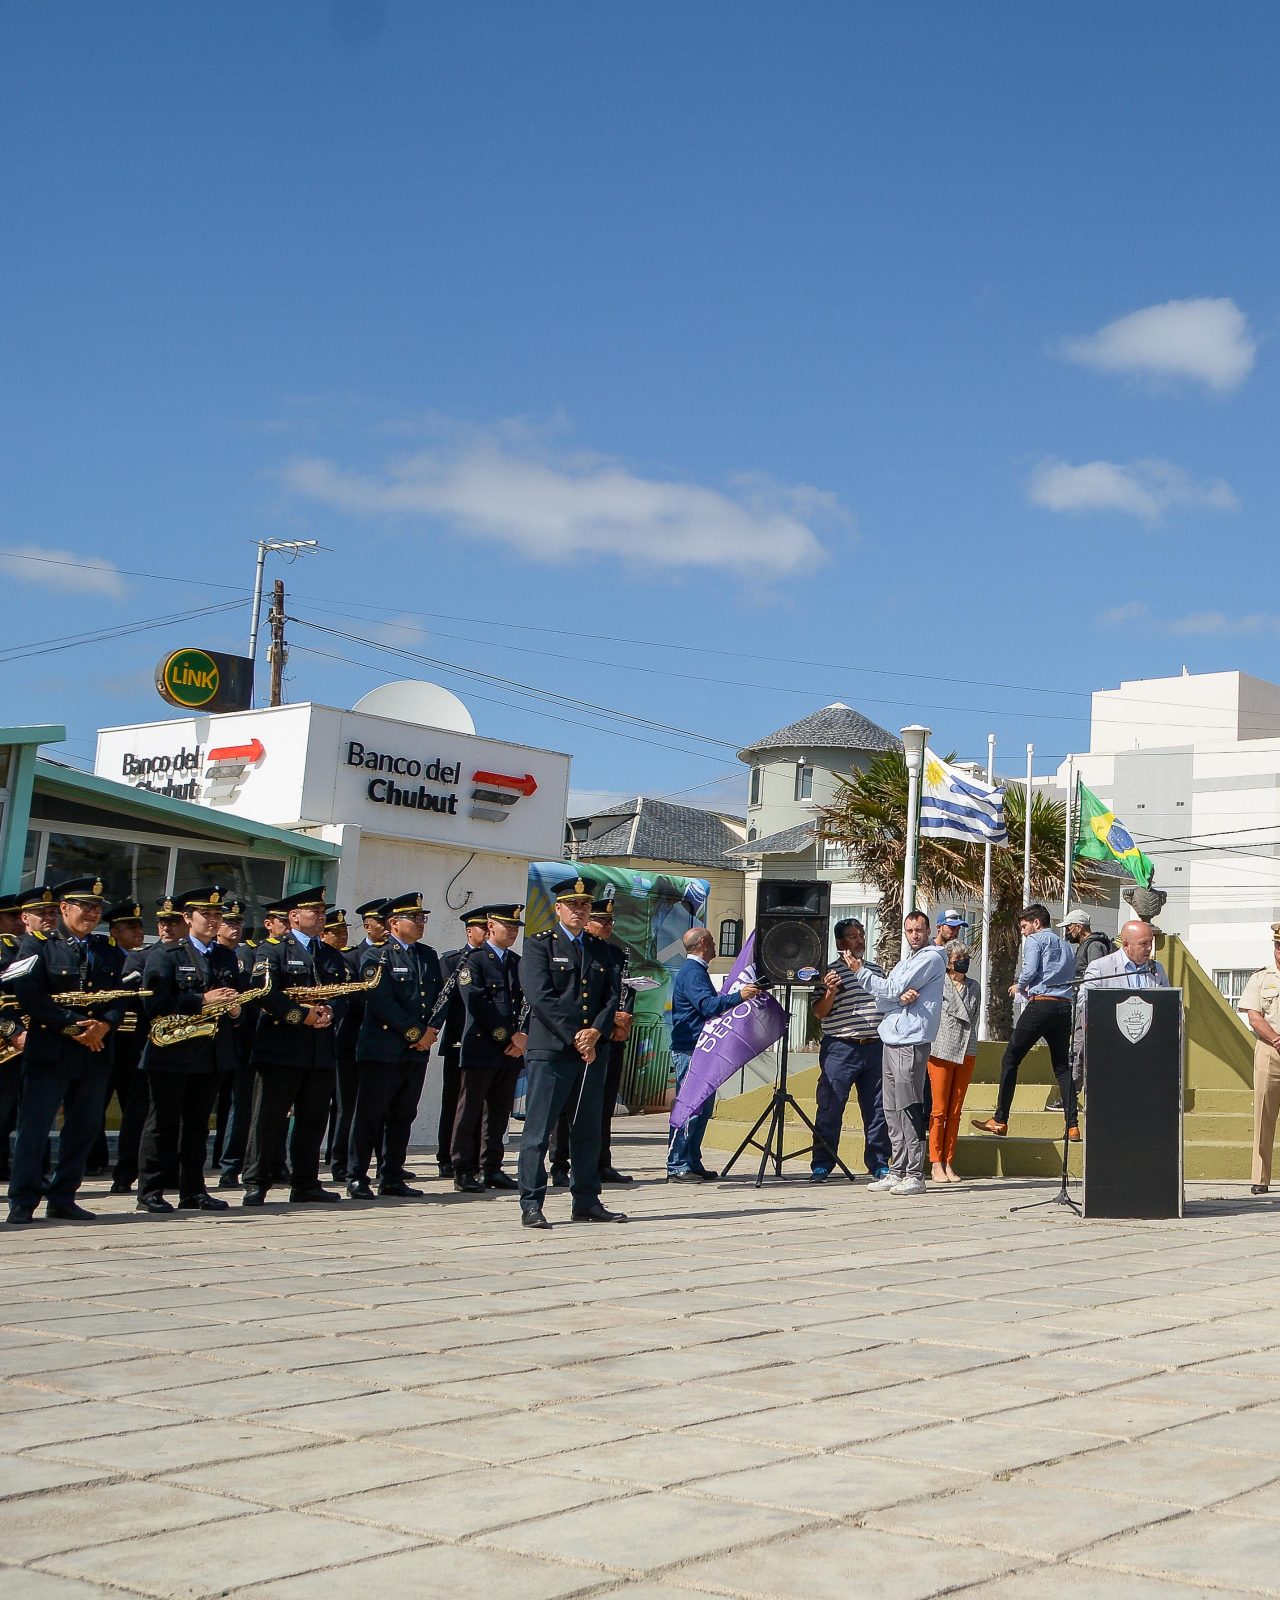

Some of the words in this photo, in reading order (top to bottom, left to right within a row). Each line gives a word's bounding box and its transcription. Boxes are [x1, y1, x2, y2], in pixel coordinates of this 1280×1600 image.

[122, 754, 170, 776] Banco
[173, 745, 200, 770] del
[347, 741, 421, 777] Banco
[425, 758, 462, 784] del
[367, 778, 459, 815] Chubut
